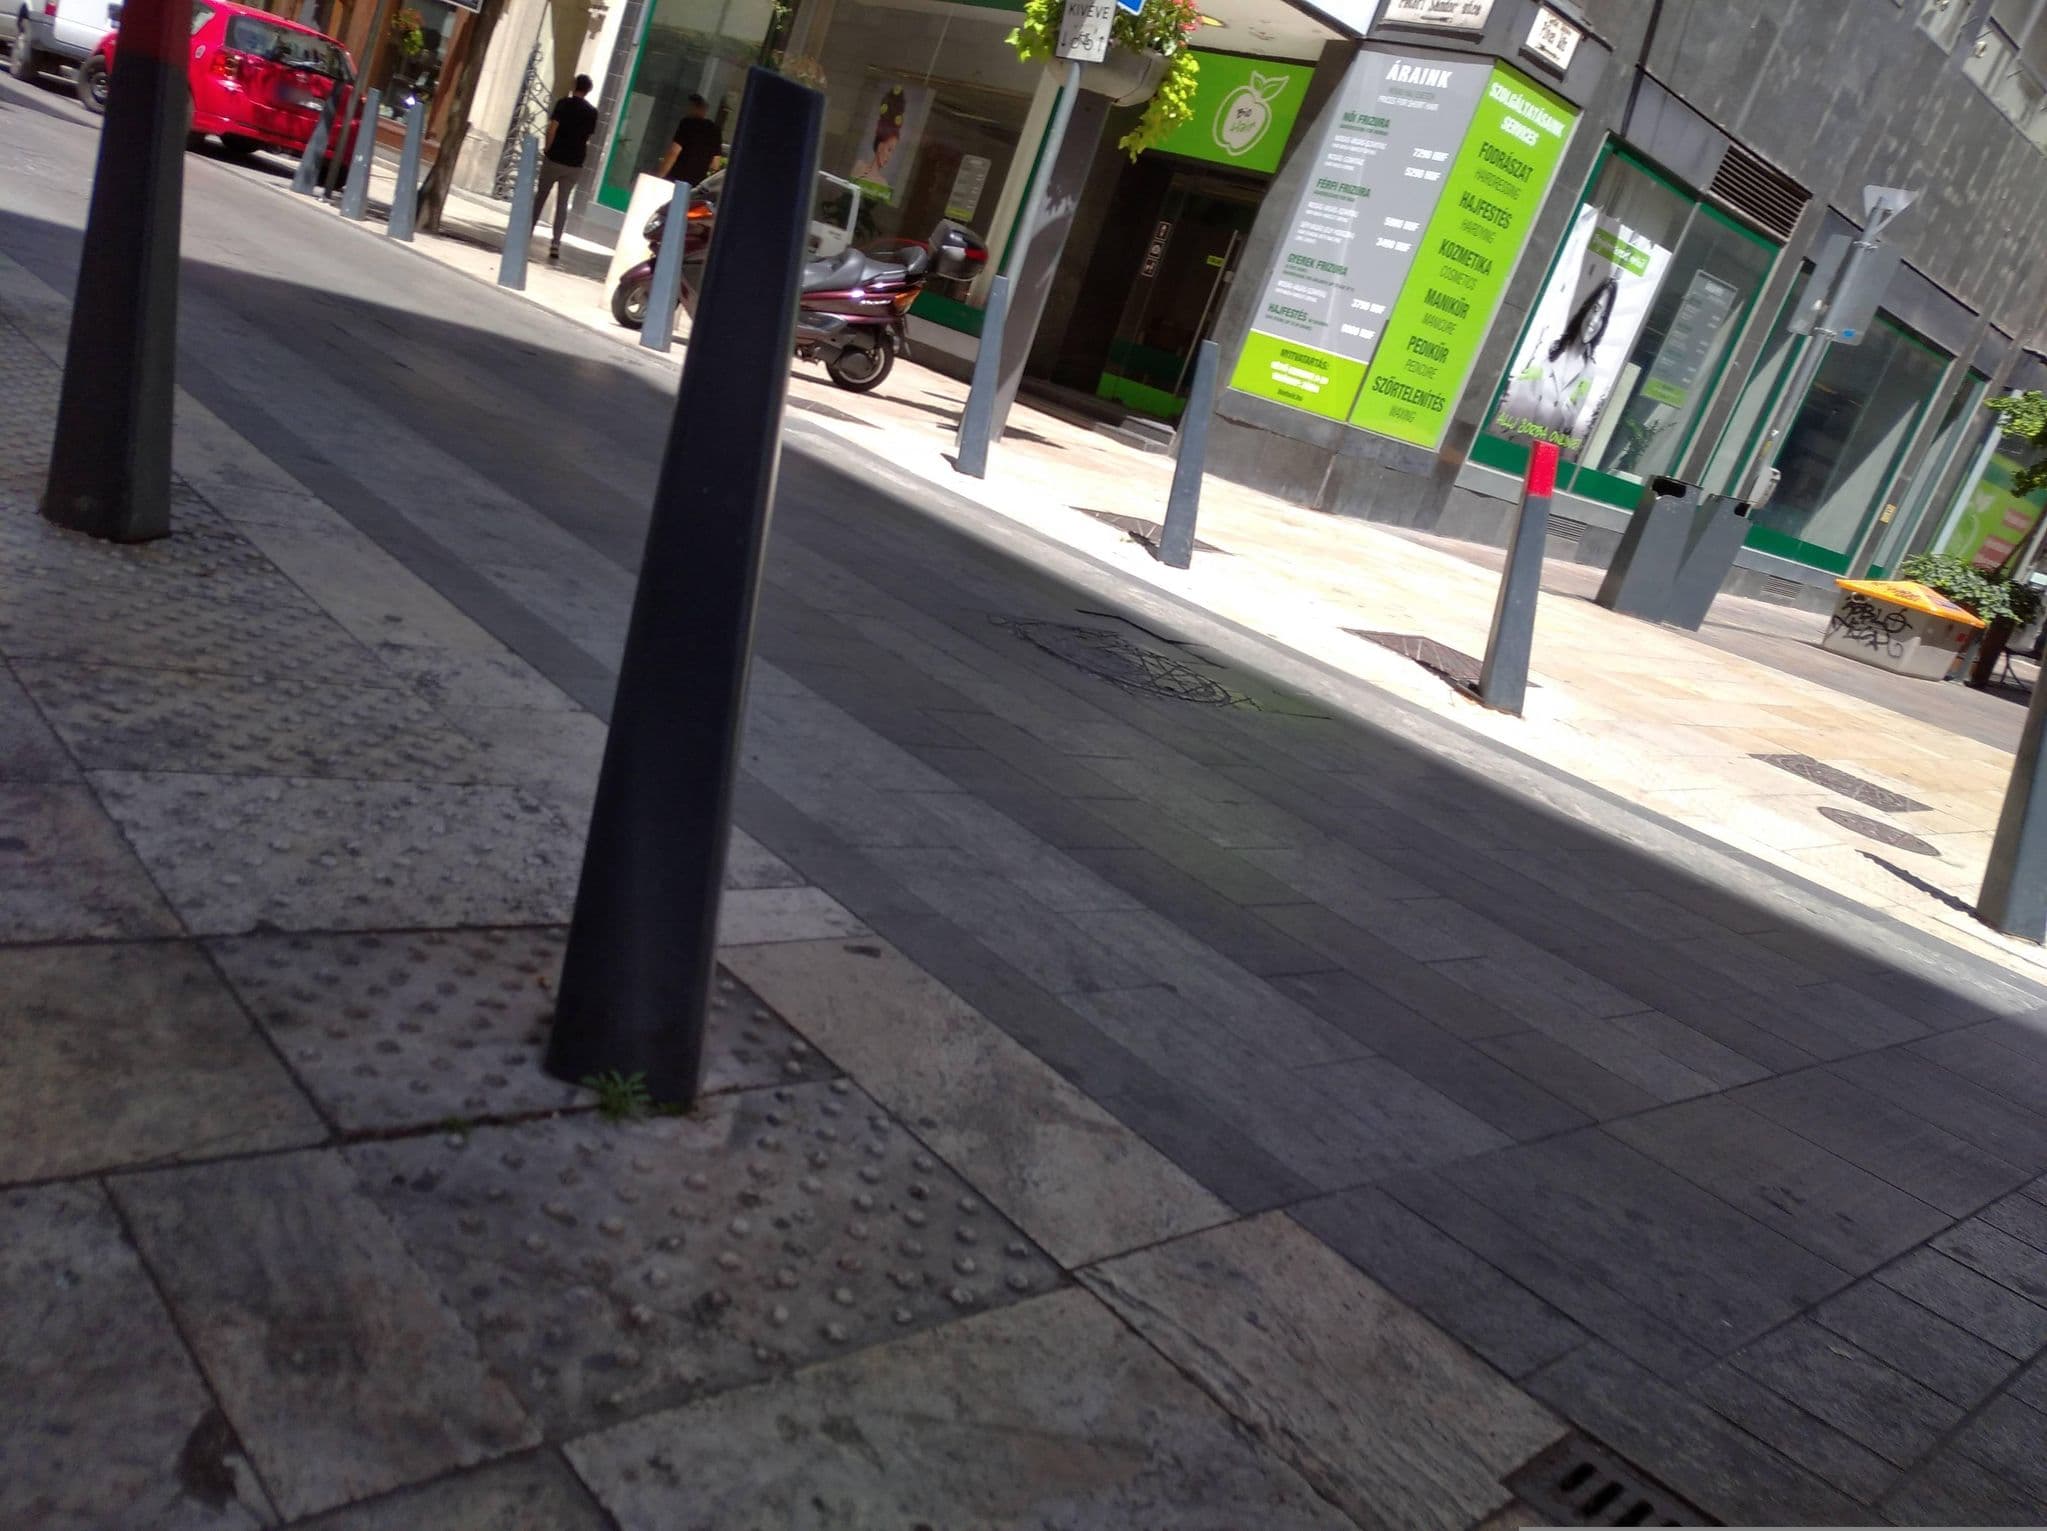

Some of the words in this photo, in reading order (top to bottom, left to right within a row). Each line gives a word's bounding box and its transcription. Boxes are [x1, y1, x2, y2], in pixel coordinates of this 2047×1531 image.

[1385, 59, 1453, 88] ÁRAINK
[1479, 141, 1533, 183] FODRÁSZAT
[1459, 190, 1512, 229] HAJFESTÉS
[1438, 238, 1493, 276] KOZMETIKA
[1372, 375, 1446, 413] SZŐRTELENÍTÉS
